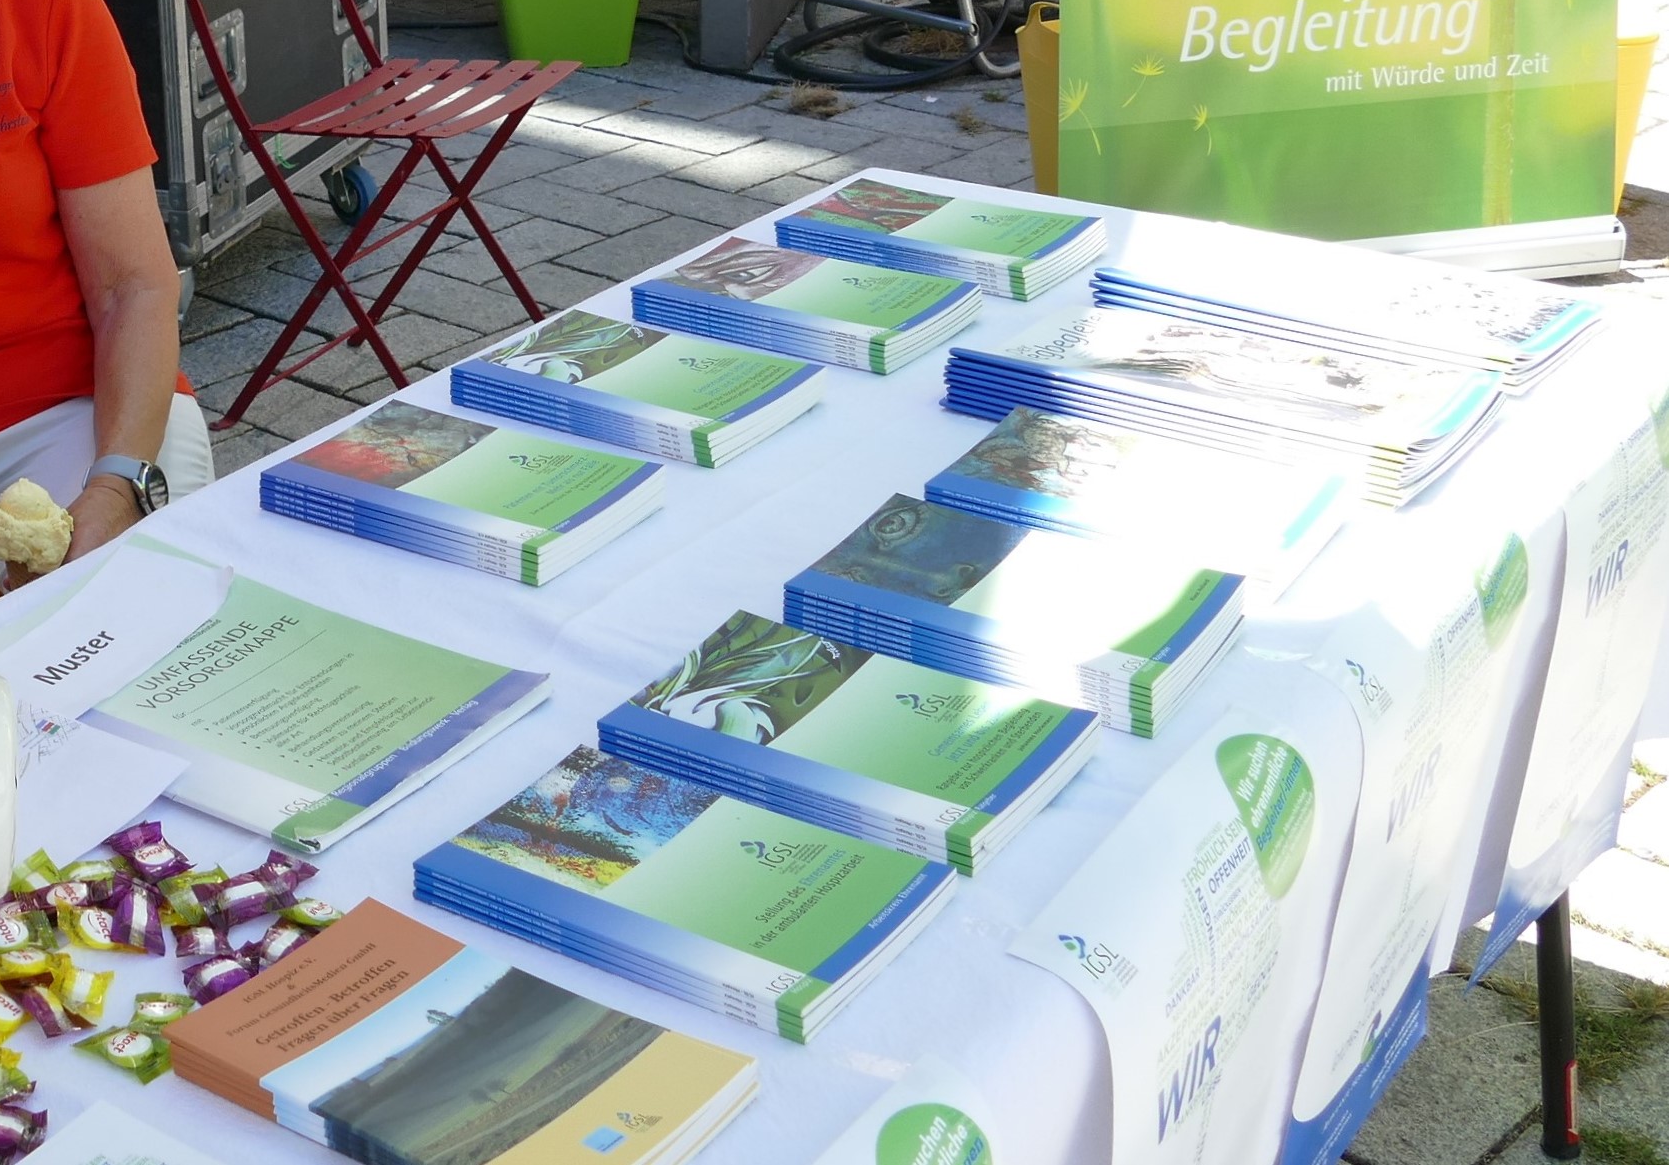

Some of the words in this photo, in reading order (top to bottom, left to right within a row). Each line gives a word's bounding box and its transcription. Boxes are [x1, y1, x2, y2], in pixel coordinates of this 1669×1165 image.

[1324, 69, 1363, 94] mit
[1370, 61, 1446, 90] Würde
[1453, 55, 1498, 83] und
[1505, 51, 1550, 78] Zeit
[1584, 538, 1629, 620] WIR
[33, 629, 116, 688] Muster
[135, 614, 301, 711] VORSORGEMAPPE
[136, 620, 259, 692] UMFASSENDE
[914, 694, 952, 719] IGSL
[1236, 778, 1255, 803] Wir
[1248, 741, 1269, 781] suchen
[1250, 745, 1288, 829] ehrenamtliche
[935, 806, 969, 826] IGSL
[758, 841, 801, 870] IGSL
[1207, 835, 1253, 895] OFFENHEIT
[755, 895, 793, 924] Stellung
[787, 884, 807, 899] des
[761, 929, 779, 943] der
[814, 853, 866, 897] Hospizarbeit
[765, 972, 803, 994] IGSL
[1080, 942, 1120, 980] IGSL
[255, 1005, 326, 1046] Getroffen
[328, 957, 397, 1003] Betroffen
[276, 1018, 329, 1053] Fragen
[327, 999, 362, 1025] über
[359, 968, 411, 1004] Fragen
[1156, 1014, 1222, 1146] WIR
